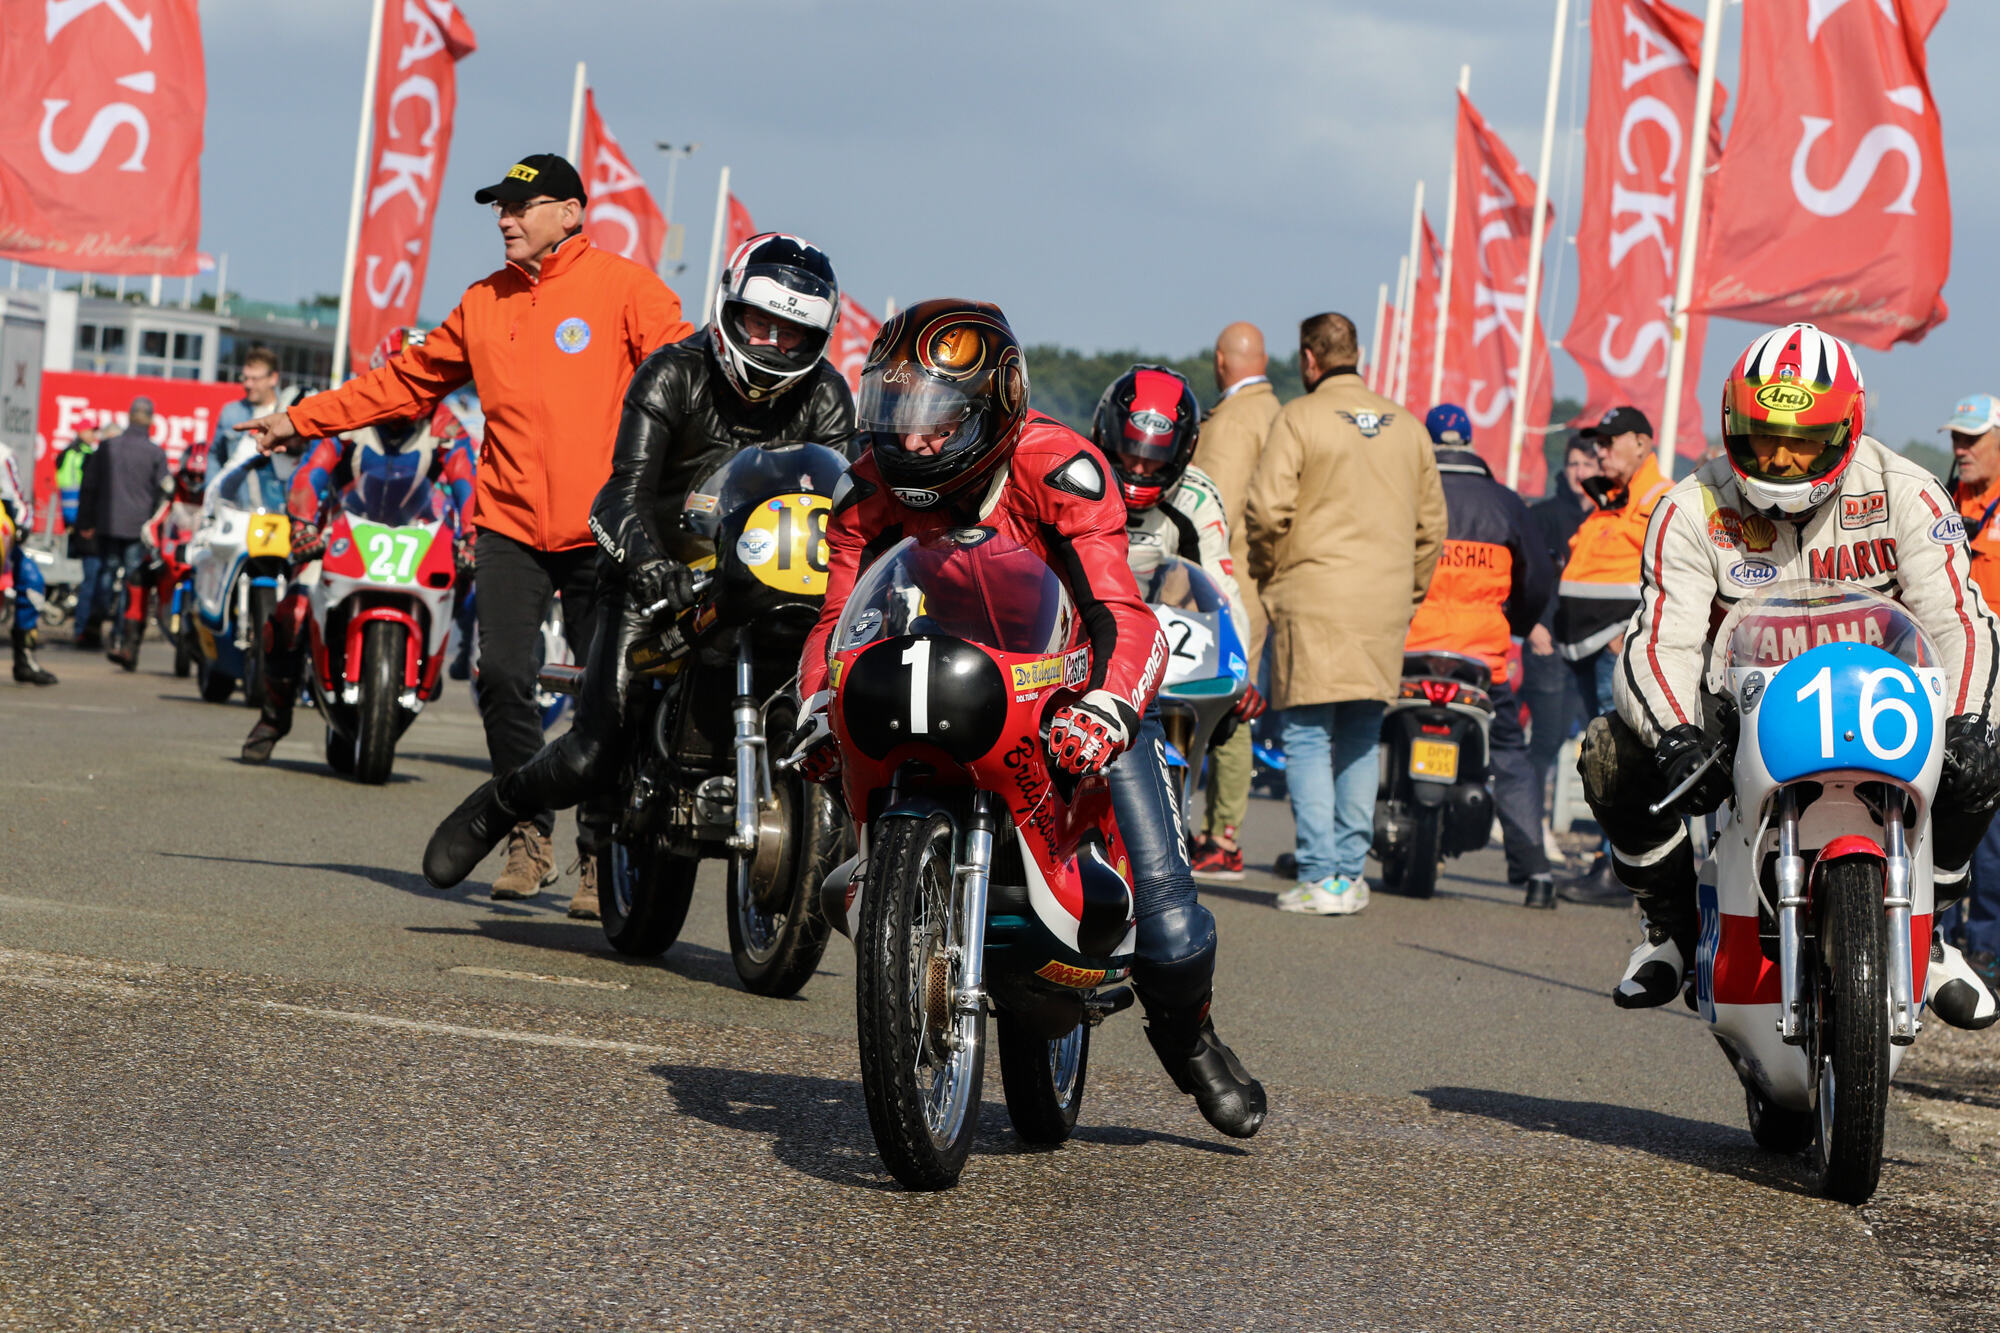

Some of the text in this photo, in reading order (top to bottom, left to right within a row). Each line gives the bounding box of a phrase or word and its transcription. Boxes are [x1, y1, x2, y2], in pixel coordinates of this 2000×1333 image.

[768, 300, 810, 318] SHARK
[882, 359, 911, 384] Jos
[1760, 387, 1806, 405] Arai
[895, 491, 932, 503] Arai
[262, 521, 279, 547] 7
[777, 506, 832, 574] 18
[369, 533, 419, 577] 27
[1735, 563, 1772, 579] Arai
[901, 640, 931, 734] 1
[1015, 666, 1031, 686] De
[1796, 666, 1918, 760] 16
[1003, 736, 1060, 864] Bridgestone
